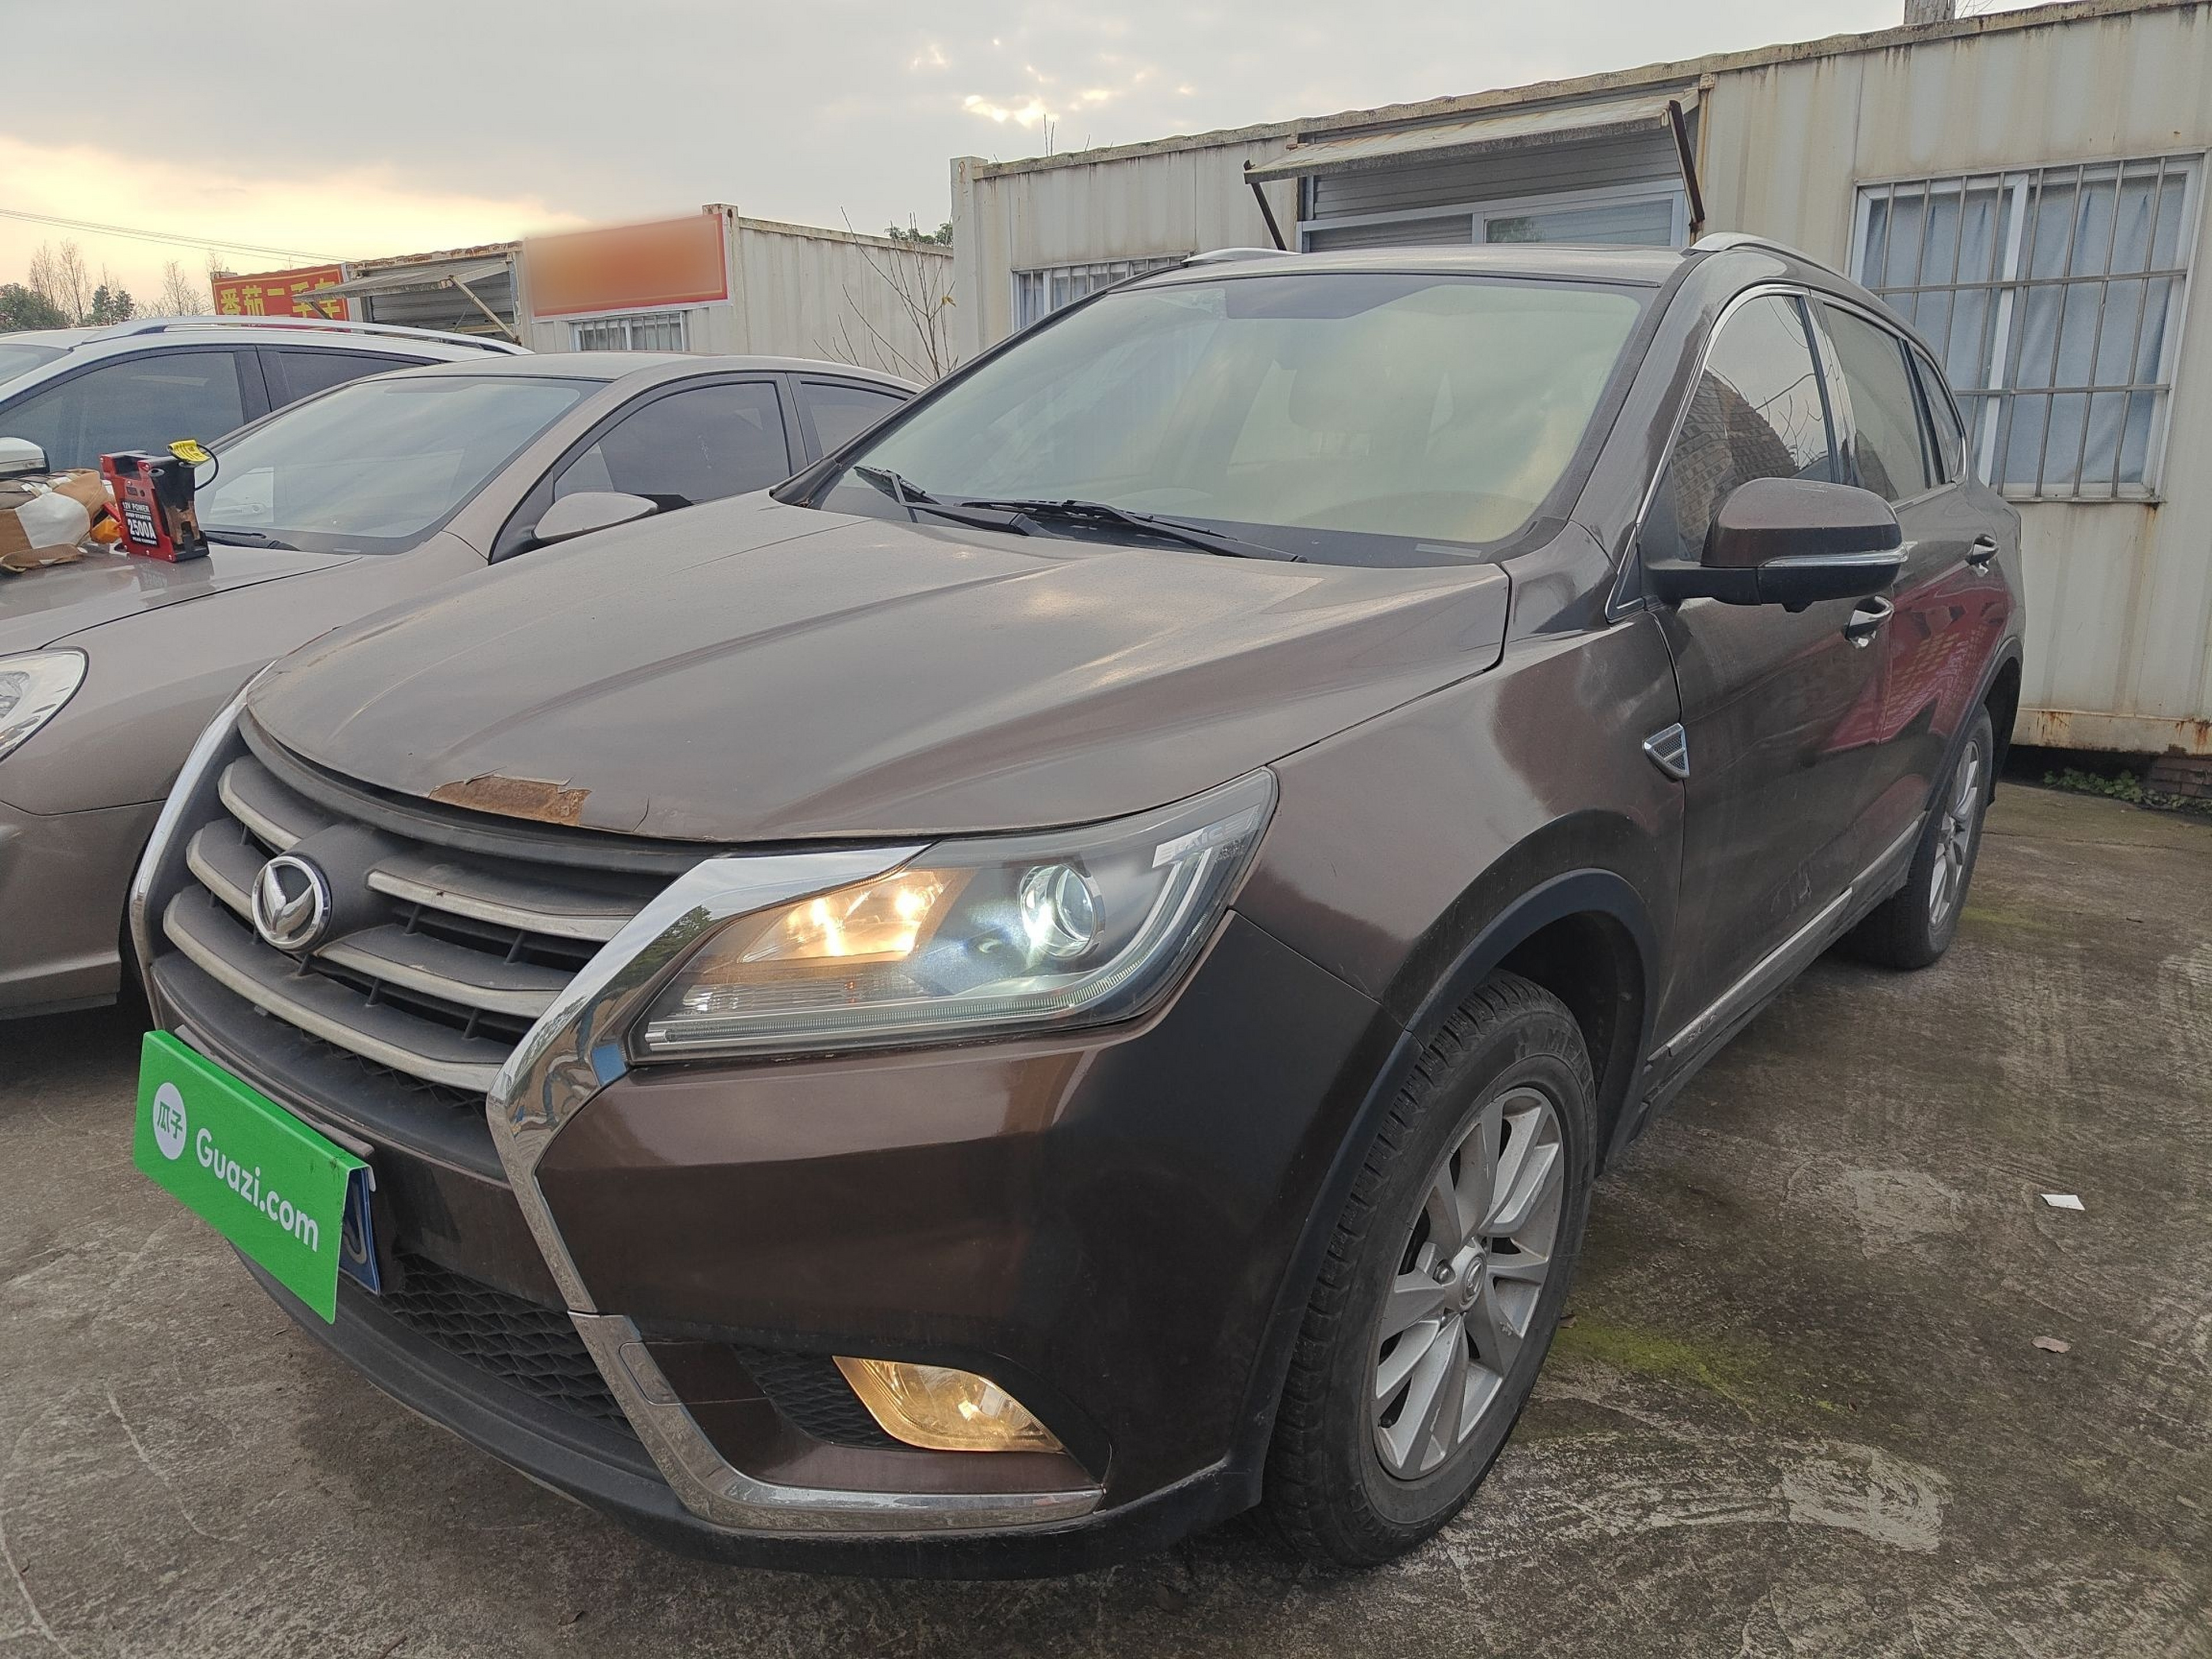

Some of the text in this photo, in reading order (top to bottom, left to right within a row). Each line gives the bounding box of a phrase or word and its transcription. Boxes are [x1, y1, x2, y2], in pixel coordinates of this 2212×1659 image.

[132, 503, 150, 512] POWER
[127, 518, 157, 539] 2500A
[157, 1100, 183, 1140] 瓜子
[196, 1127, 319, 1253] Guazi.com
